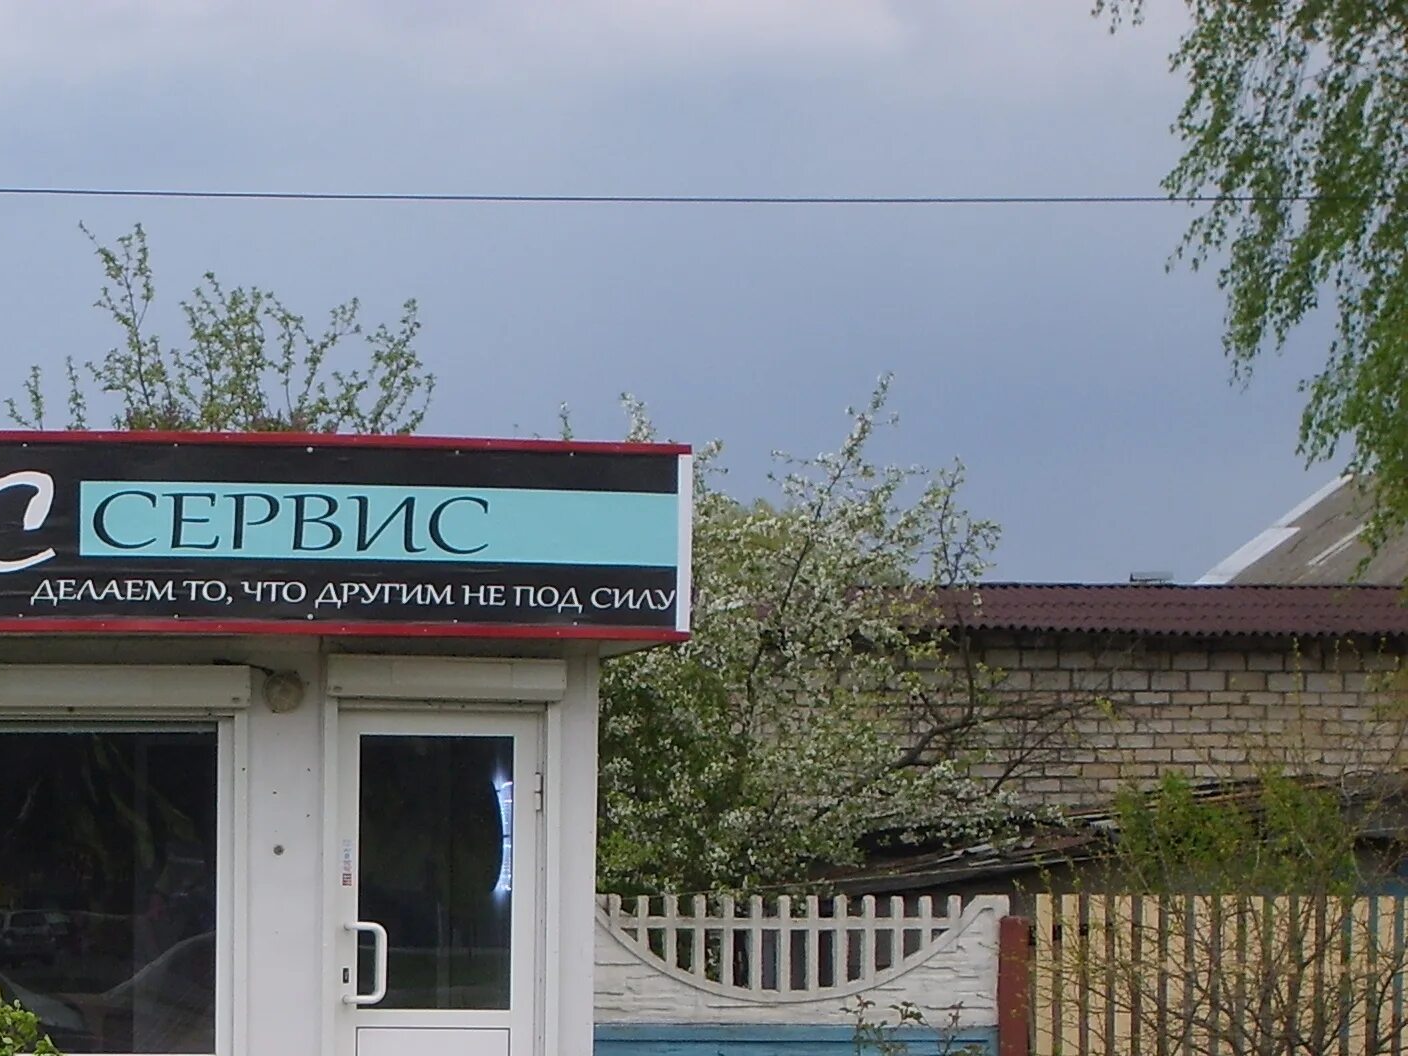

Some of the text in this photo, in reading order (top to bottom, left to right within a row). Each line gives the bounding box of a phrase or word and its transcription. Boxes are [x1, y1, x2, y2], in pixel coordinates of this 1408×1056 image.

[92, 490, 489, 555] СЕРВИС
[30, 579, 675, 614] ДЕЛАЕМ ТО, ЧТО ДРУГИМ НЕ ПОД СИЛУ
